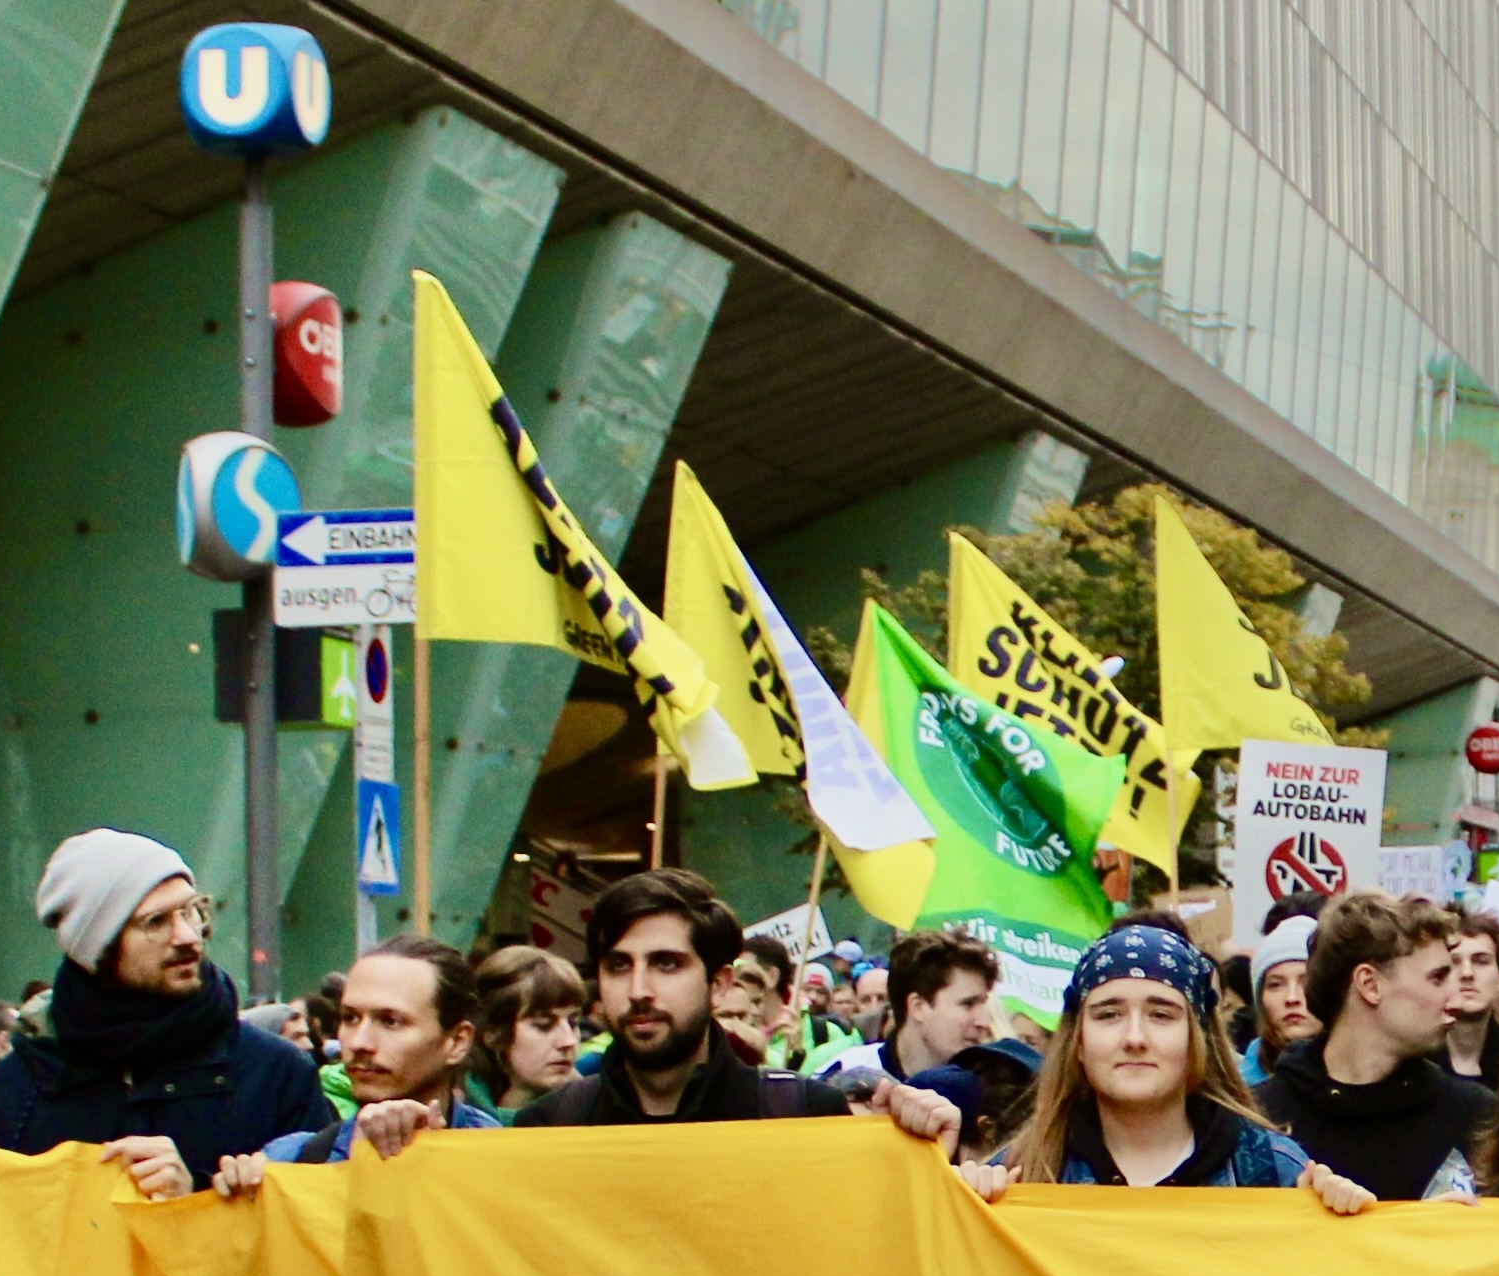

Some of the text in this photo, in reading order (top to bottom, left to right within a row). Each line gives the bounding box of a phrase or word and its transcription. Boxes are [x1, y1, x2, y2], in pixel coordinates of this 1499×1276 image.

[199, 46, 269, 127] U
[293, 49, 330, 144] U
[281, 584, 364, 611] ausgen.
[985, 713, 1047, 776] FOR
[1265, 760, 1360, 785] NEIN ZUR
[1272, 782, 1349, 803] LOBAU-
[1252, 800, 1367, 826] AUTOBAHN
[997, 831, 1073, 873] FUTURE
